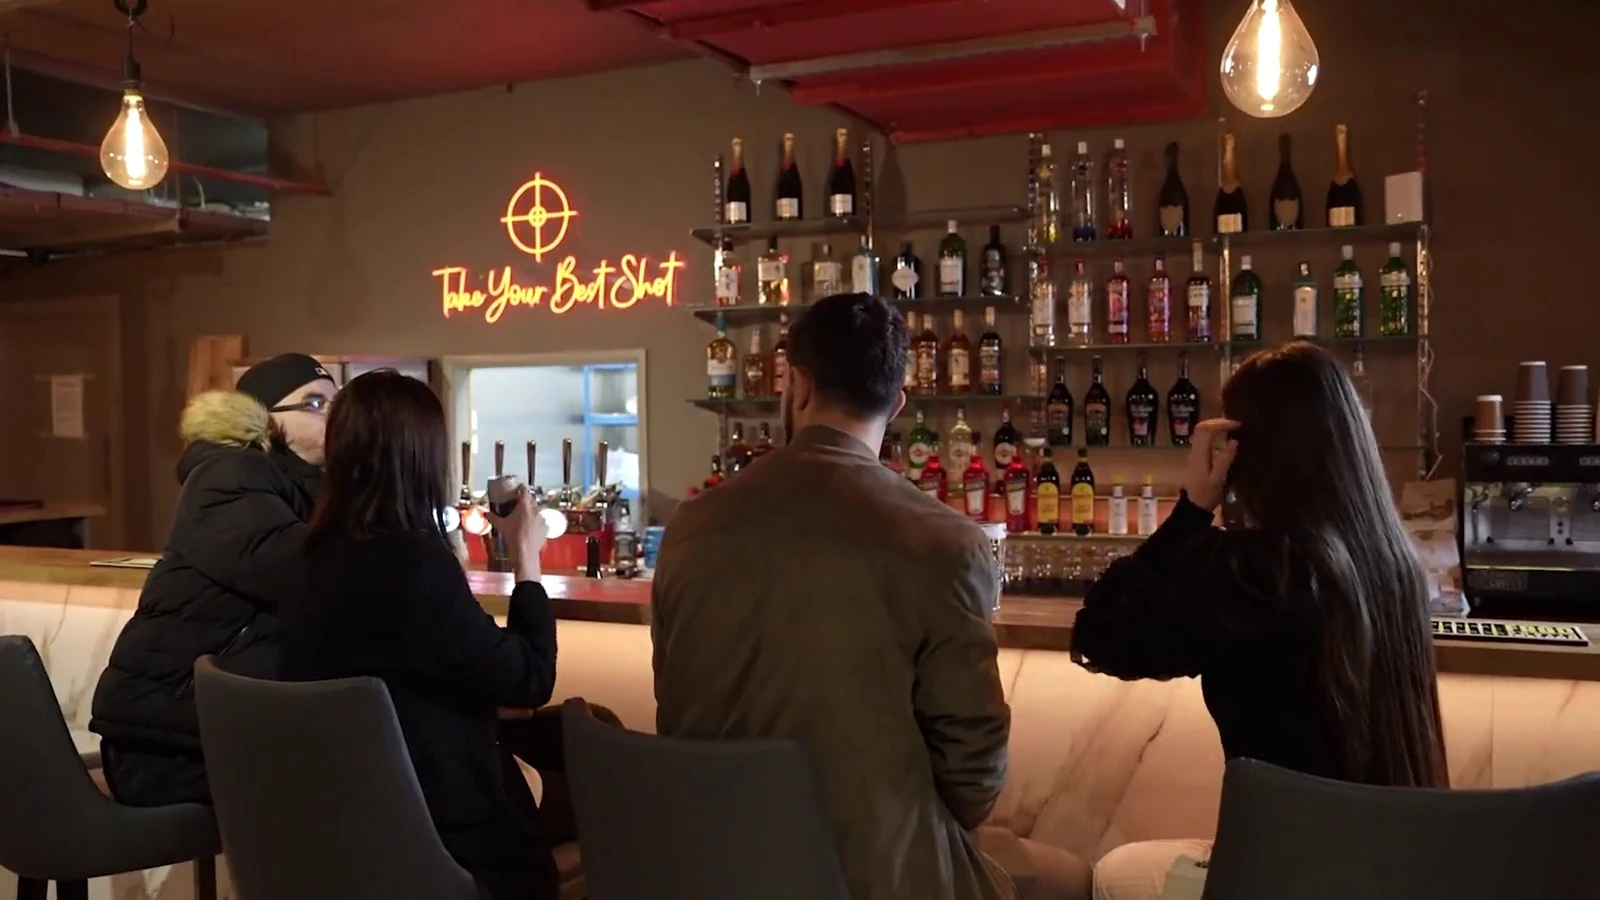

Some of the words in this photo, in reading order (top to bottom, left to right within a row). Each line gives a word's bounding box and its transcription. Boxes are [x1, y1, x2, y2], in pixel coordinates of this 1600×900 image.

[432, 267, 486, 317] Take
[486, 266, 547, 323] Your
[550, 256, 615, 313] Best
[611, 251, 685, 308] Shot
